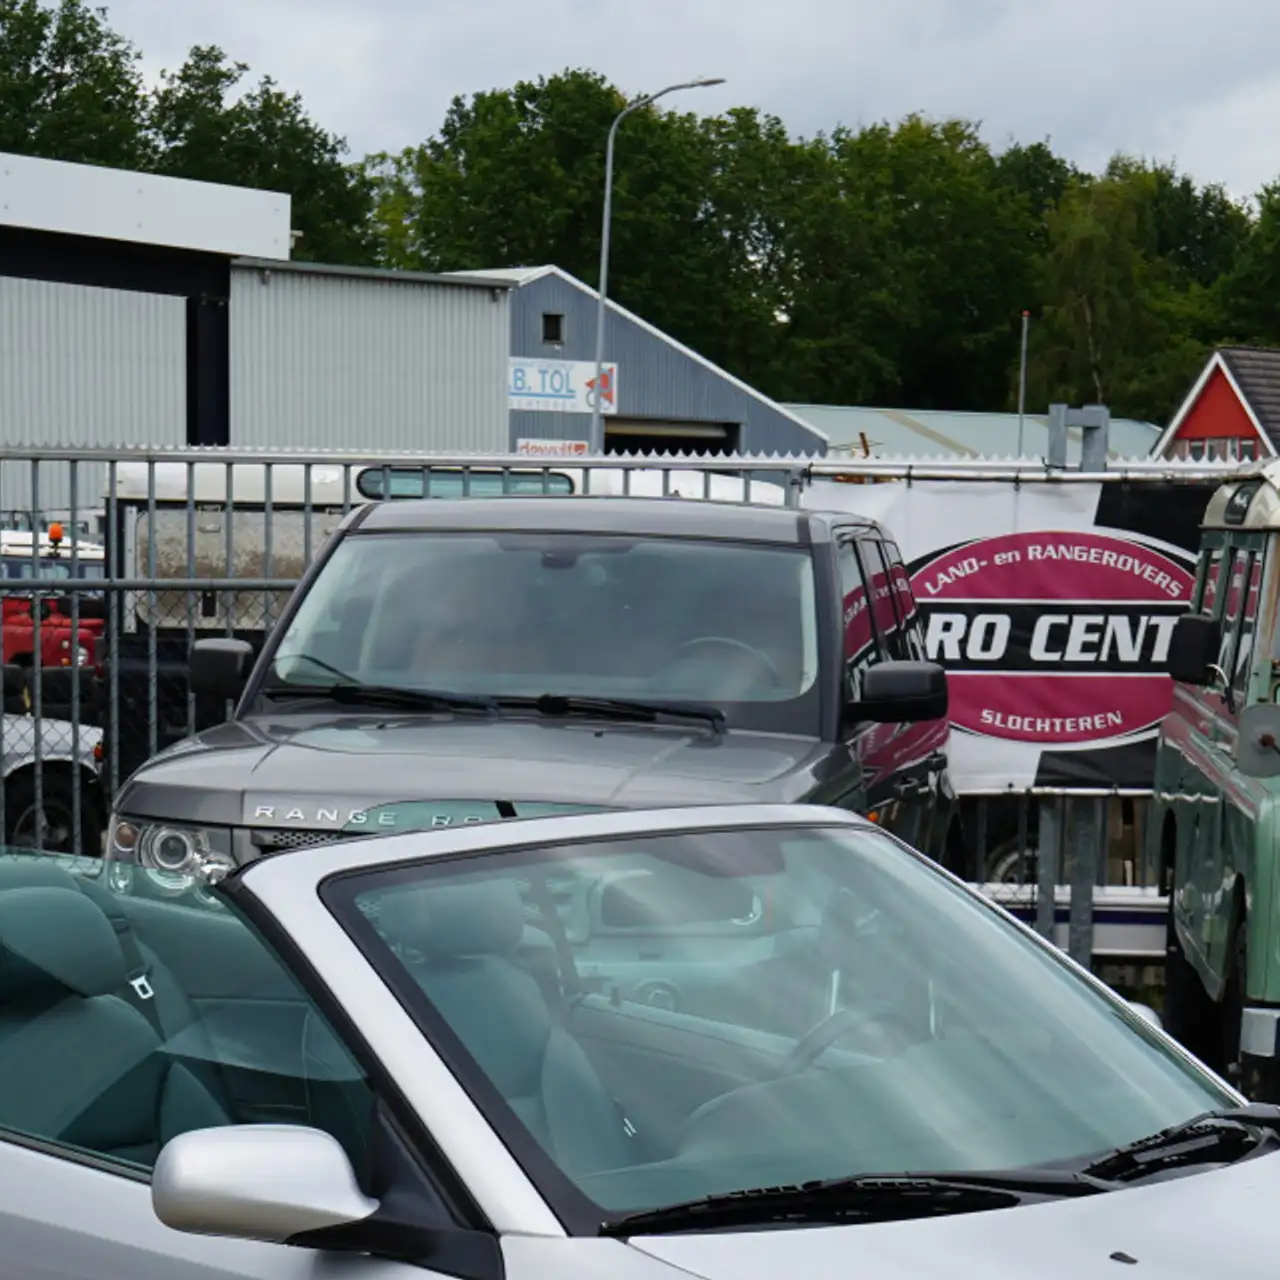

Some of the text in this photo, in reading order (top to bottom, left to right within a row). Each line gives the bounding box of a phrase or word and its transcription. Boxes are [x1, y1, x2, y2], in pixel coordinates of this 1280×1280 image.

[538, 368, 577, 394] TOL
[924, 544, 1184, 598] LAND- en RANGEROVERS
[980, 708, 1124, 733] SLOCHTEREN
[254, 805, 398, 826] RANGE
